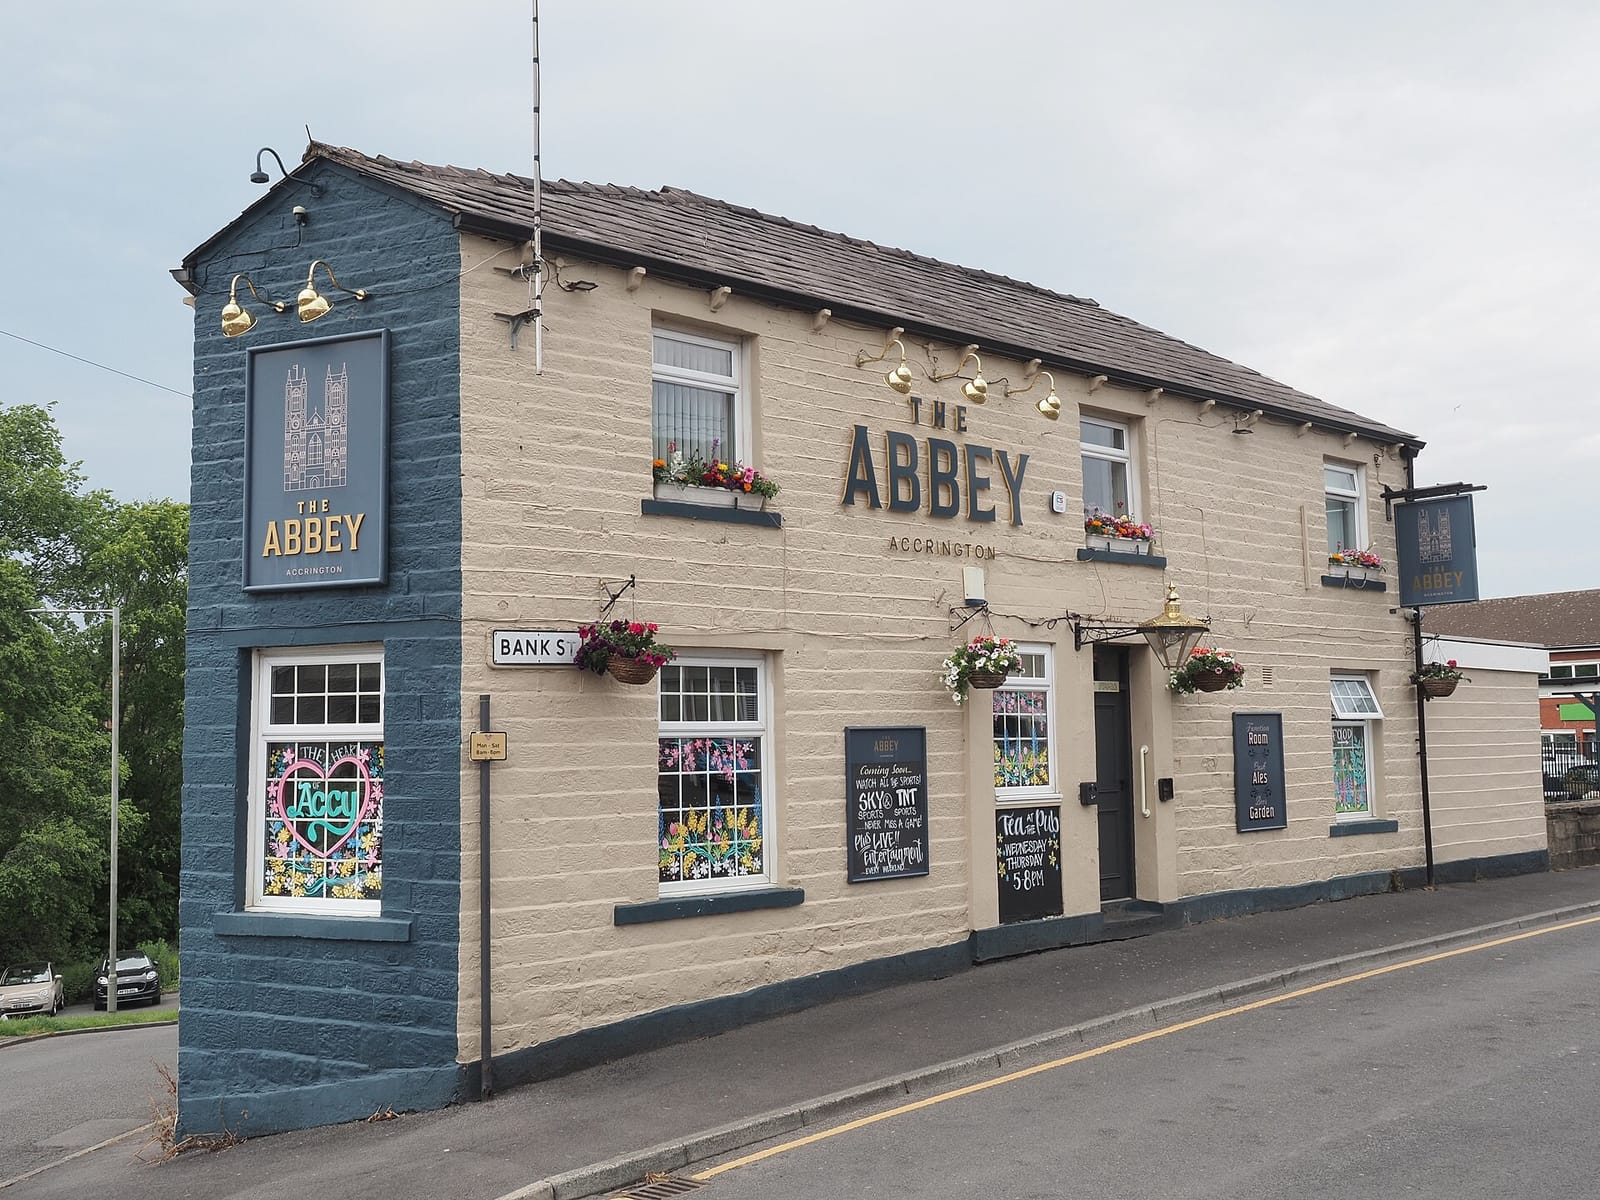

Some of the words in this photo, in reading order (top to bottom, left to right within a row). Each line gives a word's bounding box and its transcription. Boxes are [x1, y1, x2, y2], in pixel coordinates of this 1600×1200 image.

[910, 396, 967, 432] THE
[841, 424, 1030, 526] ABBEY
[297, 499, 330, 514] THE
[262, 513, 366, 557] ABBEY
[889, 536, 996, 560] ACCRINGTON
[286, 566, 343, 576] ACCRINGTON
[1413, 571, 1464, 591] ABBEY
[501, 638, 550, 656] BANK
[556, 638, 577, 657] ST
[874, 740, 899, 752] ABBEY
[1248, 732, 1269, 745] Room
[300, 746, 325, 764] THE
[860, 764, 890, 779] Coming
[1252, 772, 1268, 784] Ales
[855, 778, 877, 790] WATCH
[859, 790, 884, 812] SKY
[896, 787, 918, 808] TNT
[858, 809, 884, 821] SPORTS
[894, 806, 917, 817] SPORTS
[1249, 806, 1275, 820] Garden
[884, 819, 898, 829] MISS
[898, 818, 904, 829] A
[998, 812, 1027, 836] Tea
[1026, 813, 1034, 823] AT
[1035, 809, 1060, 836] Pub
[1004, 839, 1048, 857] WEDNESDAY
[1006, 853, 1044, 871] THURSDAY
